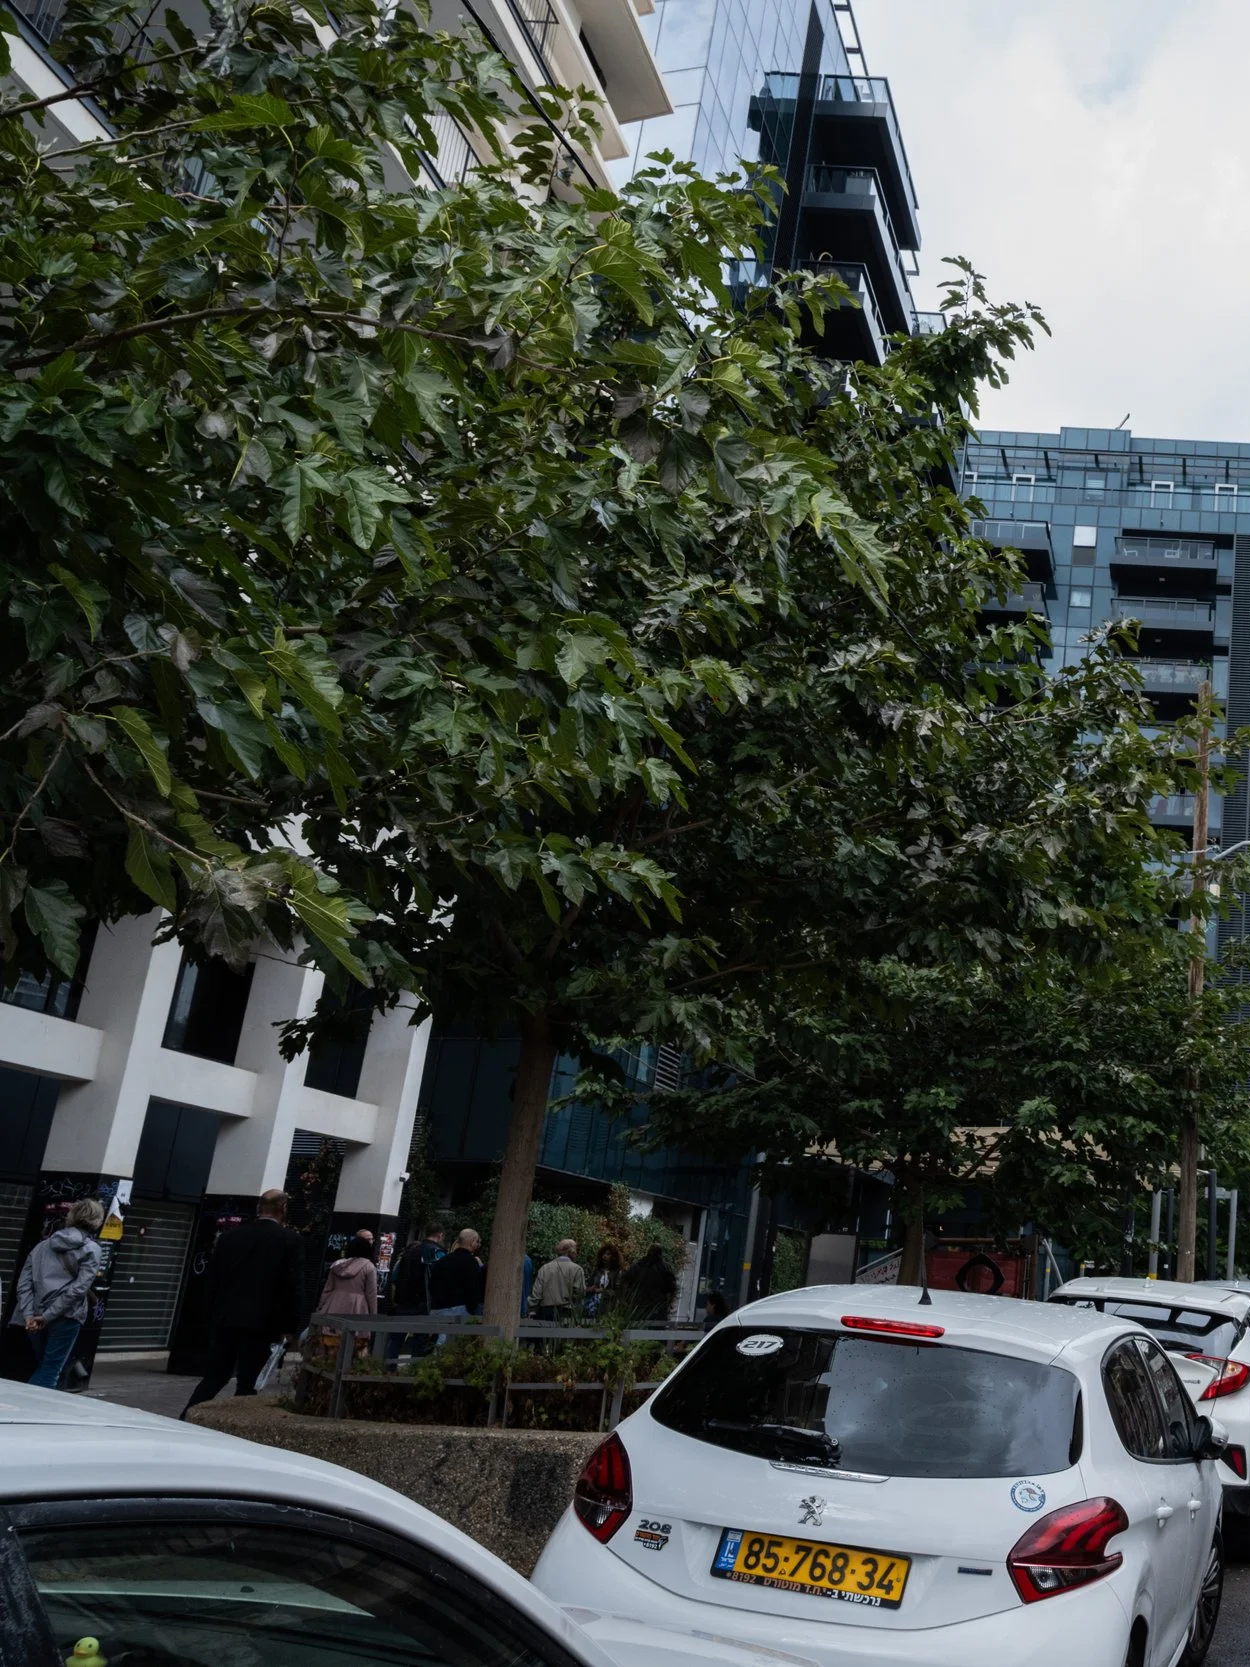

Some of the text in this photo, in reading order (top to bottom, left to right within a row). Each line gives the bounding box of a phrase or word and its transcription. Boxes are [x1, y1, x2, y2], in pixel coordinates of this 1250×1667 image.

[742, 1340, 778, 1349] 217
[638, 1519, 672, 1535] 208
[841, 1590, 881, 1606] נרכשתי
